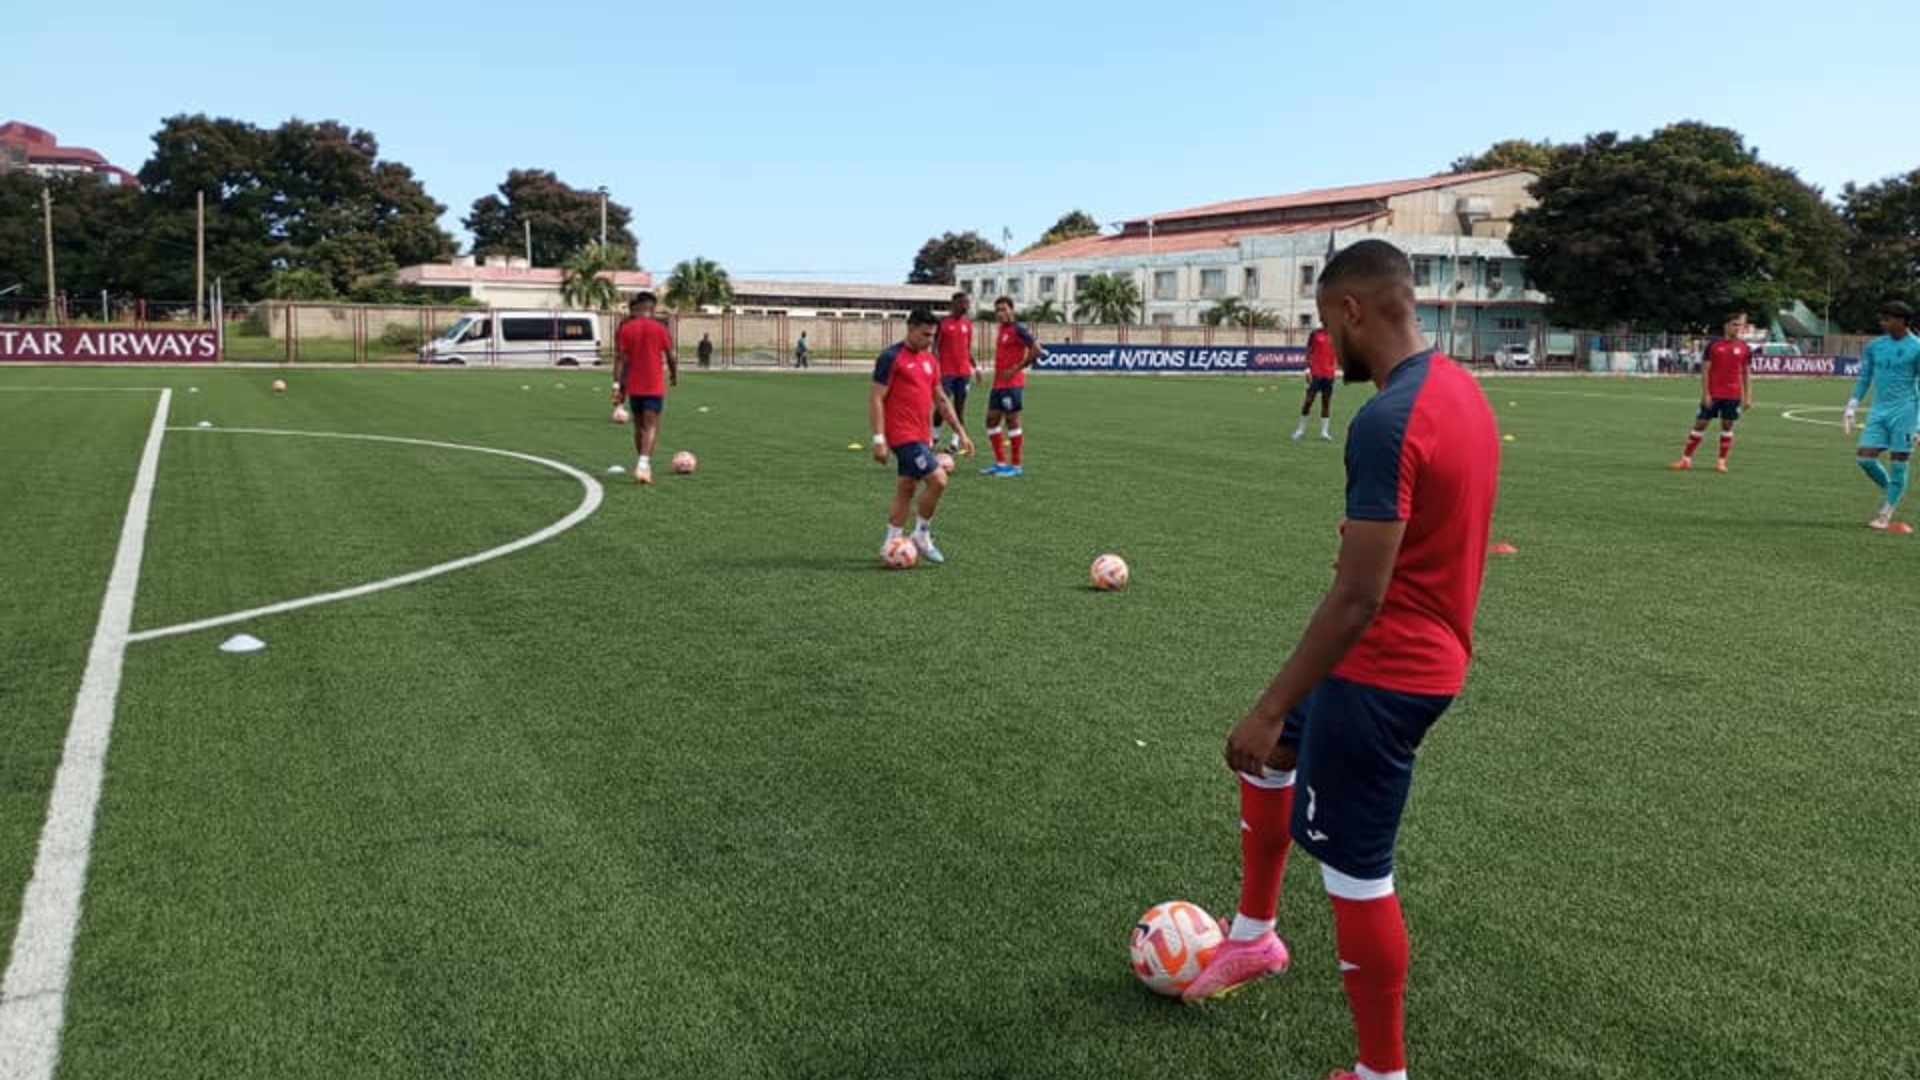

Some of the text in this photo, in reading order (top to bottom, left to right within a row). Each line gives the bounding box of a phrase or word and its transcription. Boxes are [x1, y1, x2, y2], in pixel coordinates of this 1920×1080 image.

[0, 331, 215, 356] TAR AIRWAYS
[1037, 348, 1249, 369] Concacaf NATIONS LEAGUE
[1783, 357, 1834, 372] AIRWAYS
